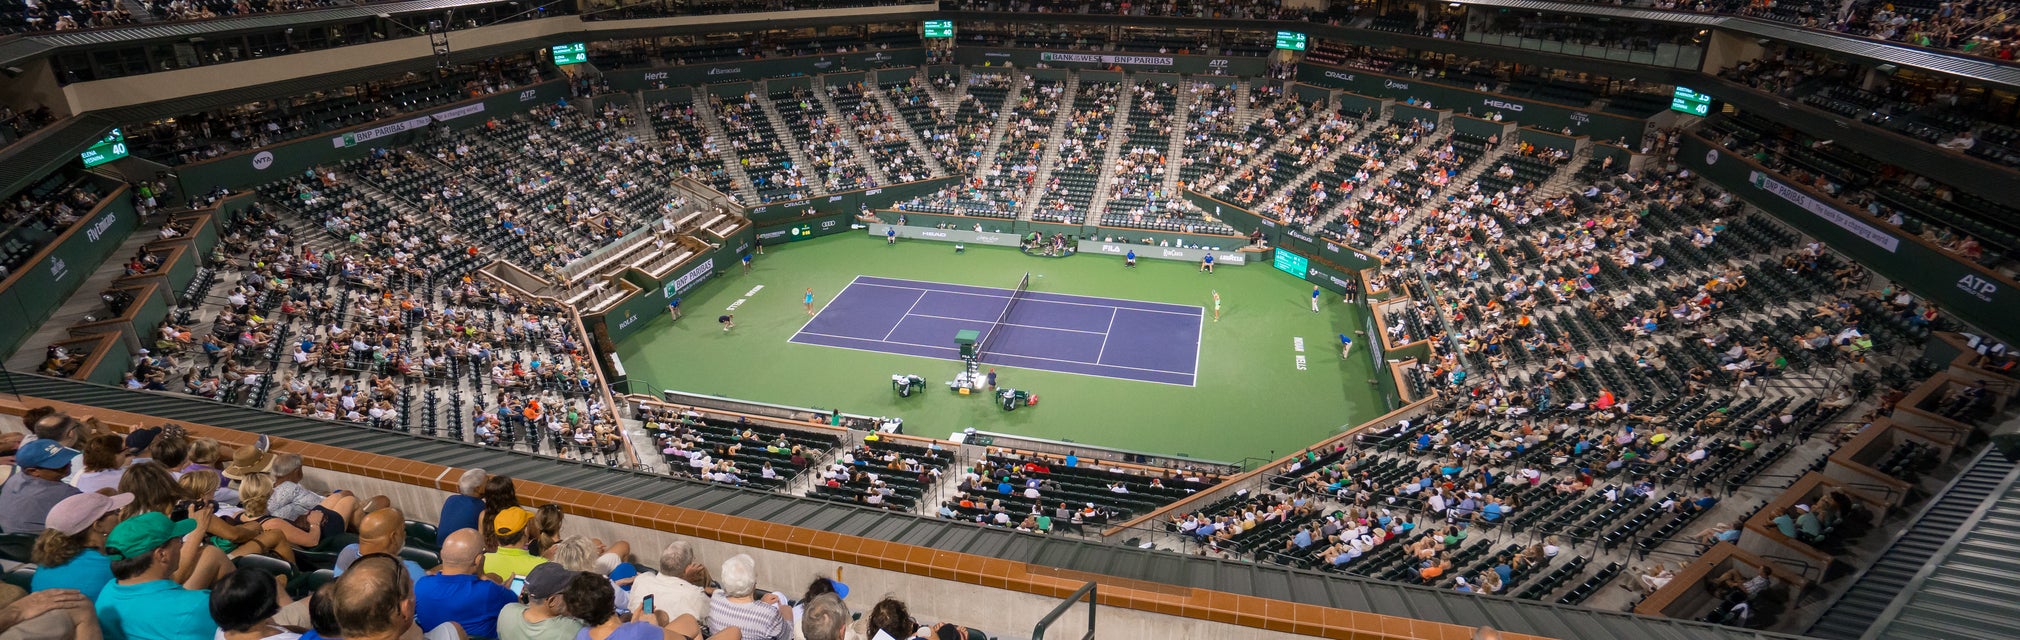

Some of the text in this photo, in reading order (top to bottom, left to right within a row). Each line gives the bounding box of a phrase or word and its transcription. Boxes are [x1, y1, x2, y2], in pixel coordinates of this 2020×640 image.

[645, 72, 668, 80] Hertz
[1325, 70, 1354, 81] ORACLE
[1392, 82, 1408, 90] pepsi
[520, 89, 536, 98] ATP
[1484, 99, 1524, 112] HEAD
[1696, 104, 1707, 113] 40
[1570, 114, 1590, 123] ULTRA
[357, 128, 372, 141] BNP
[375, 122, 405, 137] PARIBAS
[112, 143, 126, 156] 40
[254, 155, 272, 166] WTA
[1765, 178, 1778, 192] BNP
[1779, 185, 1806, 205] PARIBAS
[87, 228, 98, 242] Fly
[1354, 252, 1367, 261] WTA
[676, 276, 688, 288] BNP
[690, 261, 712, 280] PARIBAS
[1958, 274, 1996, 293] ATP
[619, 315, 638, 330] ROLEX
